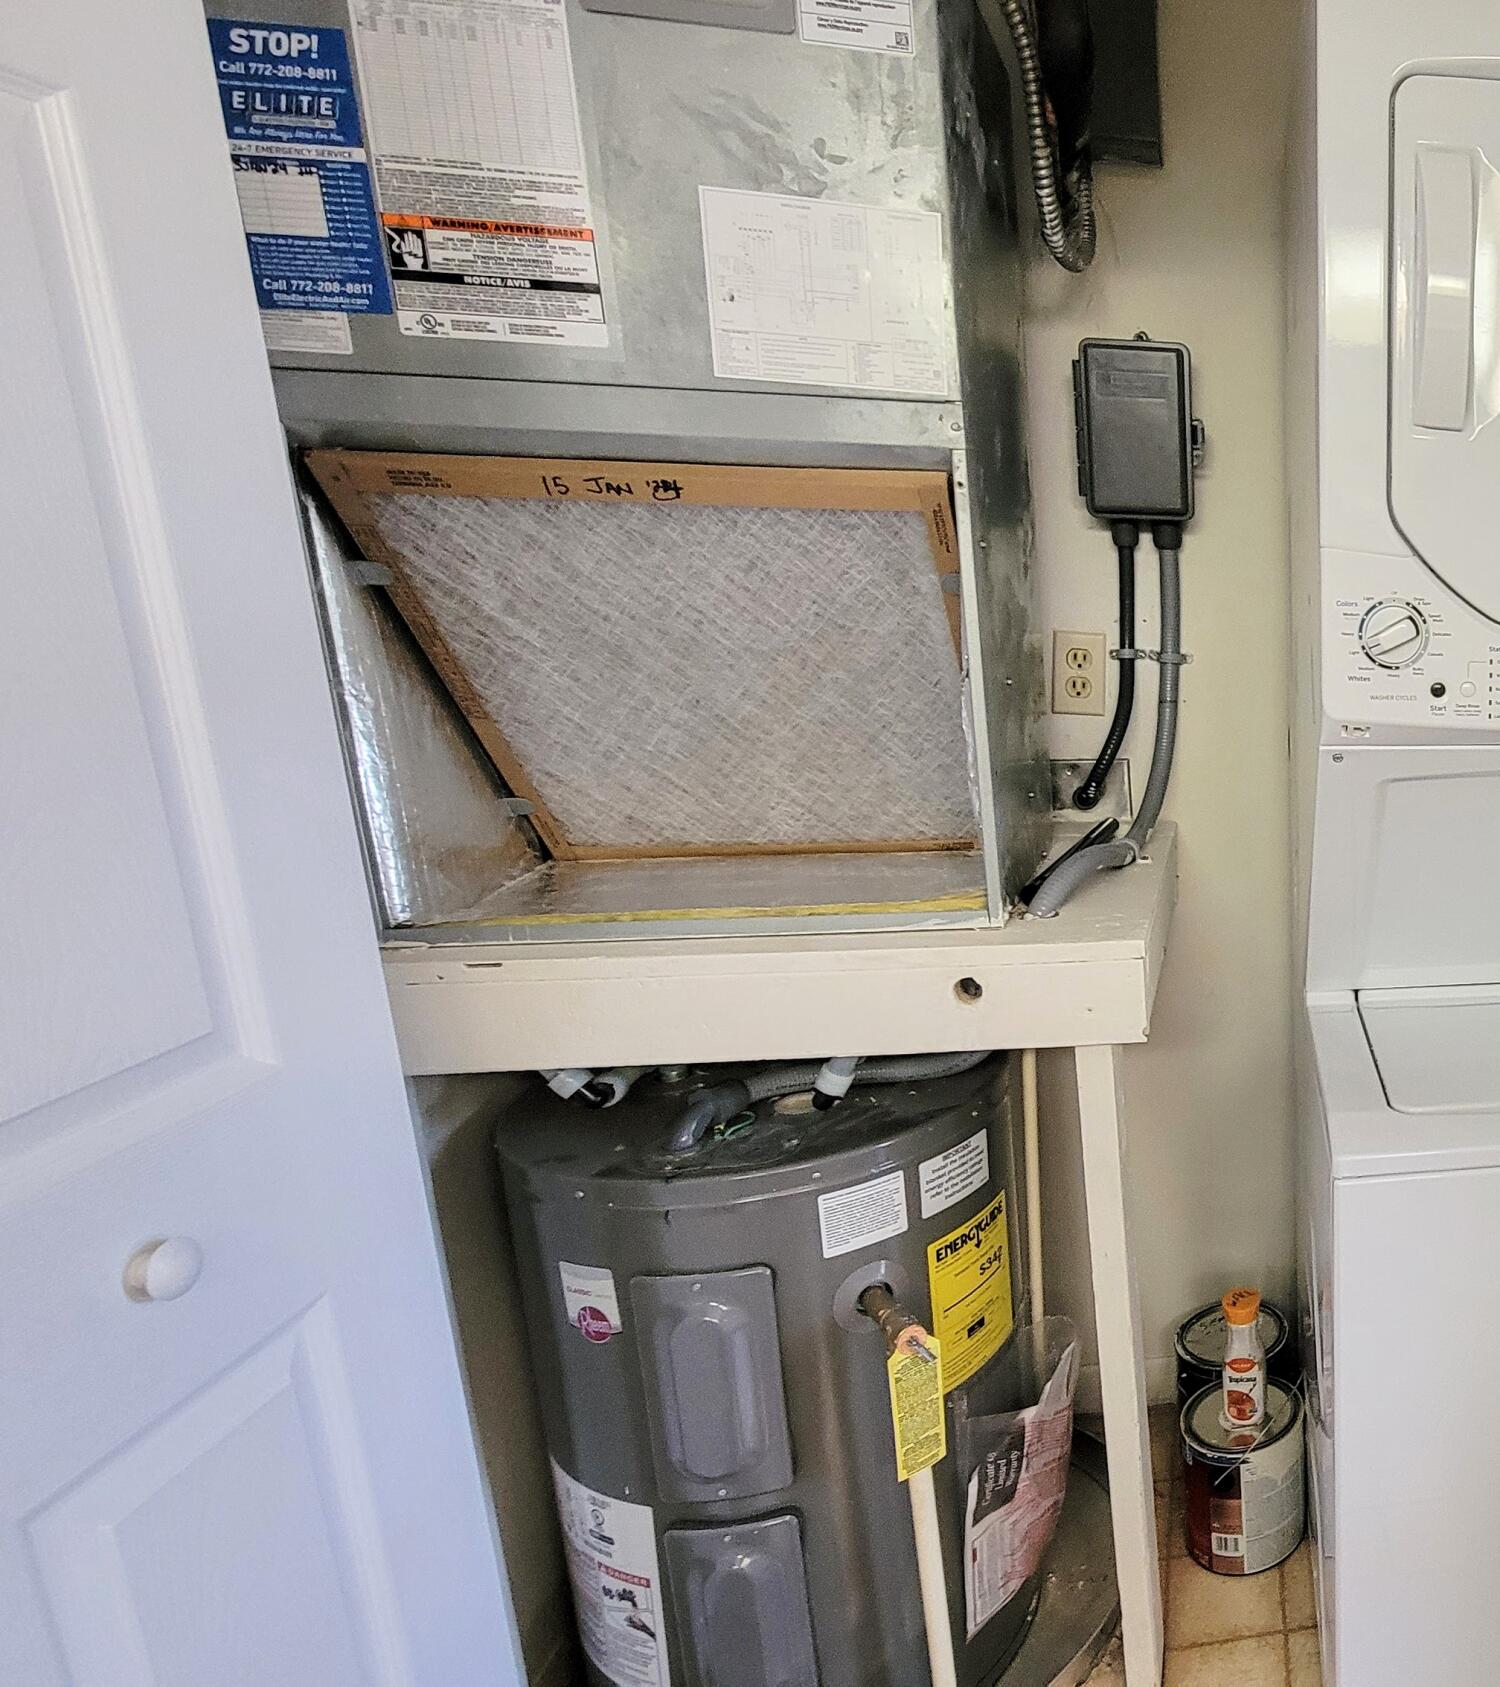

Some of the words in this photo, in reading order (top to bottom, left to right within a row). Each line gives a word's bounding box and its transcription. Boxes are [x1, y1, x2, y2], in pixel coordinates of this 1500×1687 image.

[229, 28, 318, 59] STOP!
[219, 61, 245, 73] Call
[249, 62, 337, 81] 772-208-8811
[232, 91, 333, 115] ELITE
[256, 145, 311, 155] EMERGENCY
[314, 148, 352, 159] SERVICE
[263, 279, 287, 290] Call
[291, 280, 373, 295] 772-208-8811
[463, 274, 531, 289] NOTICE/AVIS
[541, 475, 570, 497] 15
[582, 476, 634, 496] JAN
[1430, 704, 1447, 712] Start
[936, 1200, 1003, 1263] ENERGYGUIDE
[1228, 1375, 1257, 1384] Tropicana
